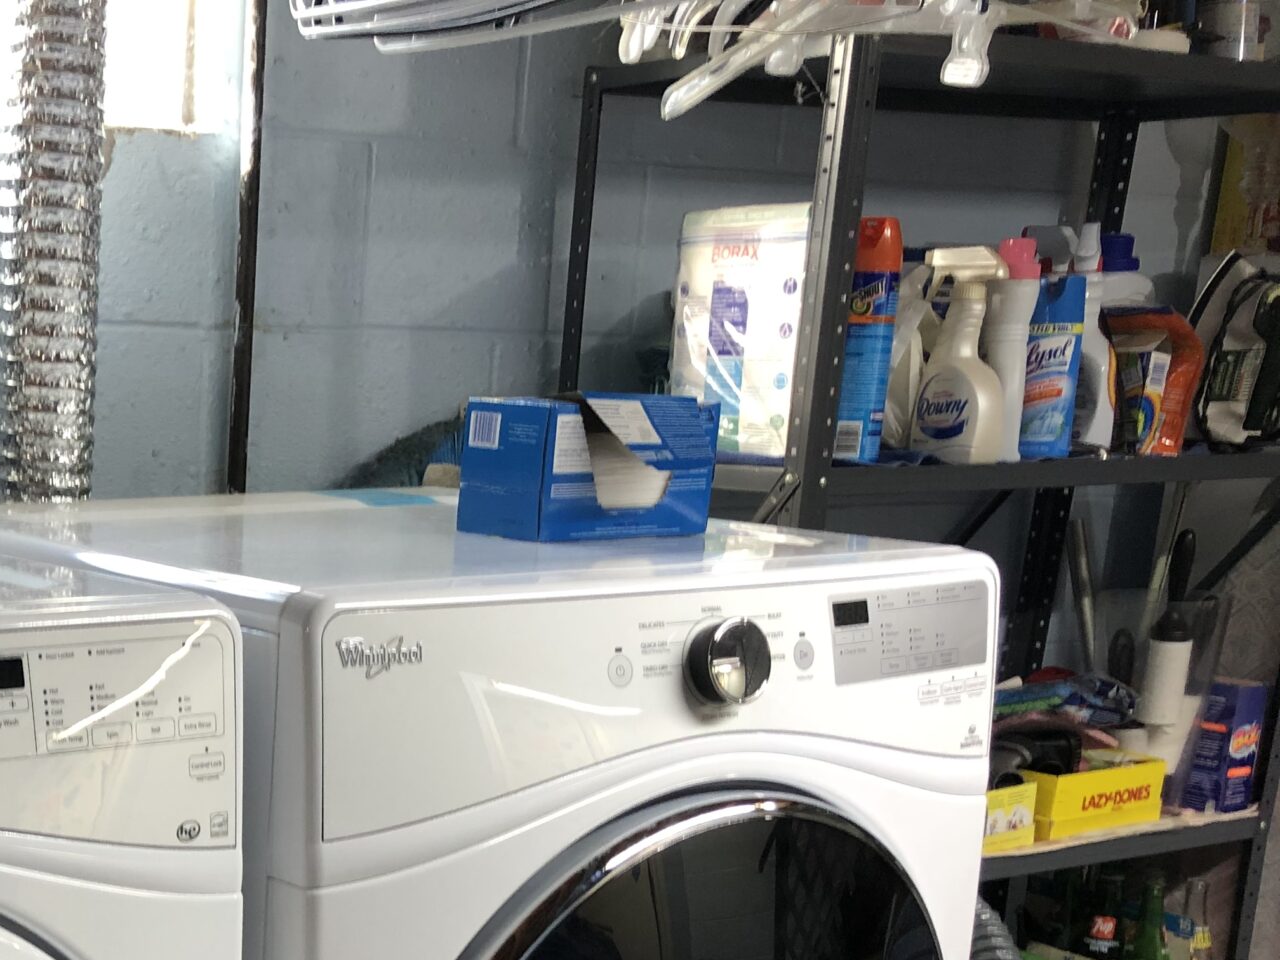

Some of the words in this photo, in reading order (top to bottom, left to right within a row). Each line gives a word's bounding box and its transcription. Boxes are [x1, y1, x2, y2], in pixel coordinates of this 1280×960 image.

[710, 242, 759, 264] BORAX
[858, 277, 887, 302] SHOUT
[1026, 339, 1073, 371] Lysol
[919, 397, 968, 422] Downy
[335, 637, 423, 678] Whirlpool
